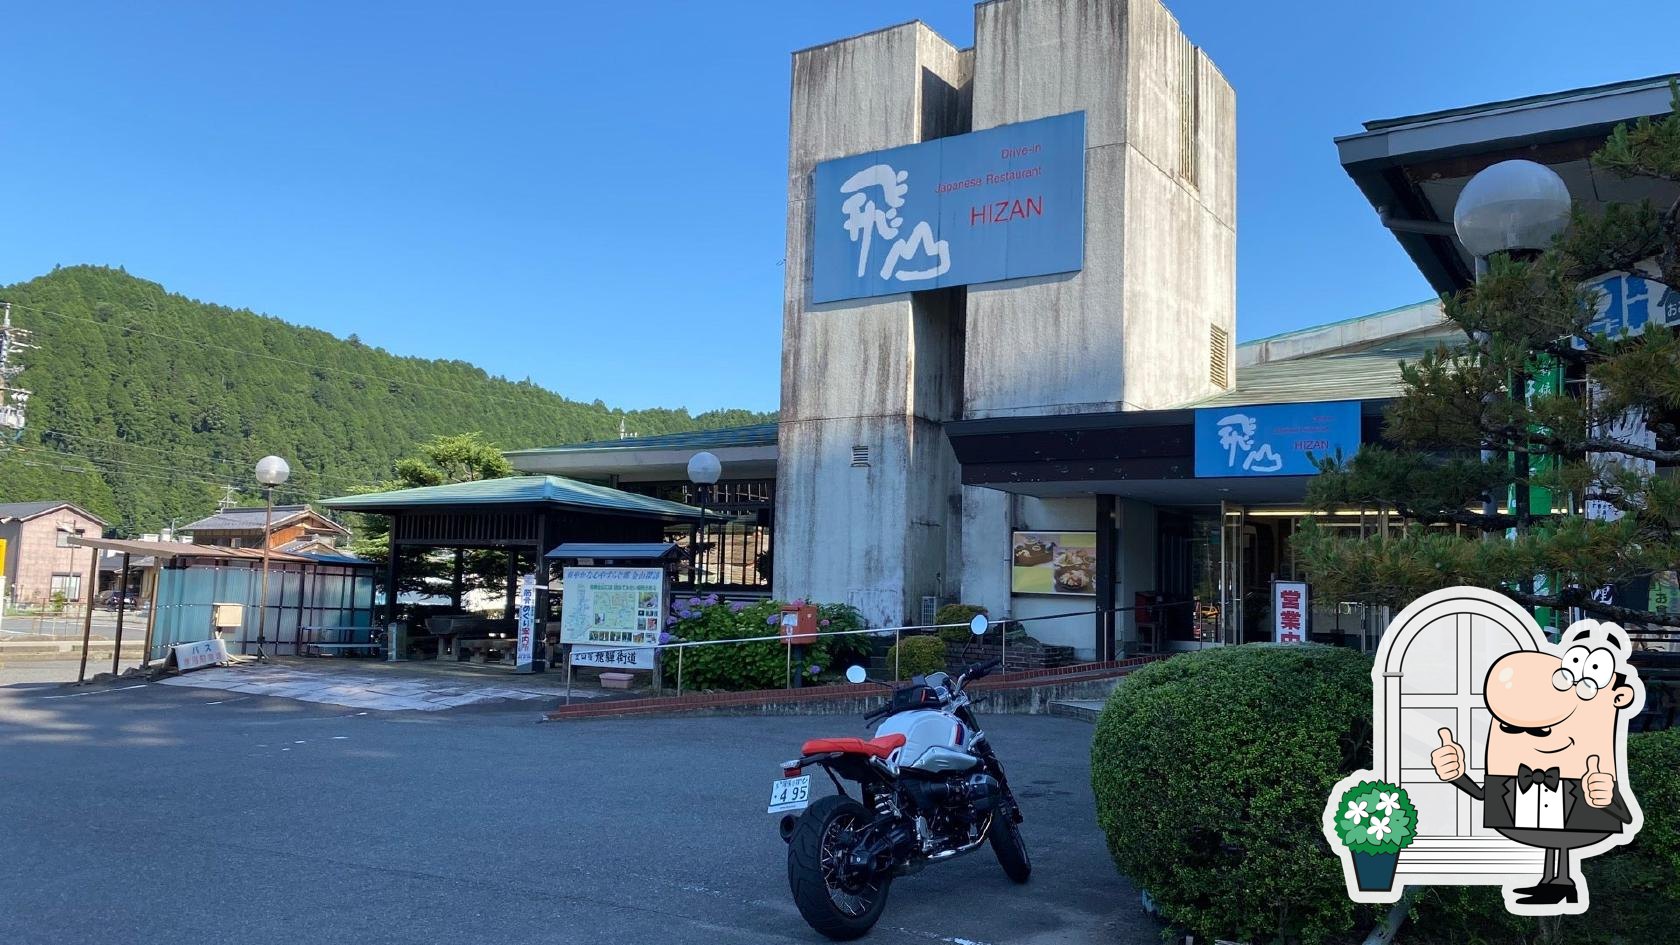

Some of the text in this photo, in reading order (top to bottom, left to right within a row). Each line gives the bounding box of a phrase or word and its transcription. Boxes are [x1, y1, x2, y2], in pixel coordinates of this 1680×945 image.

[1001, 144, 1041, 159] Drive-in
[935, 166, 1042, 193] Japanese Restaurant
[970, 195, 1043, 226] HIZAN
